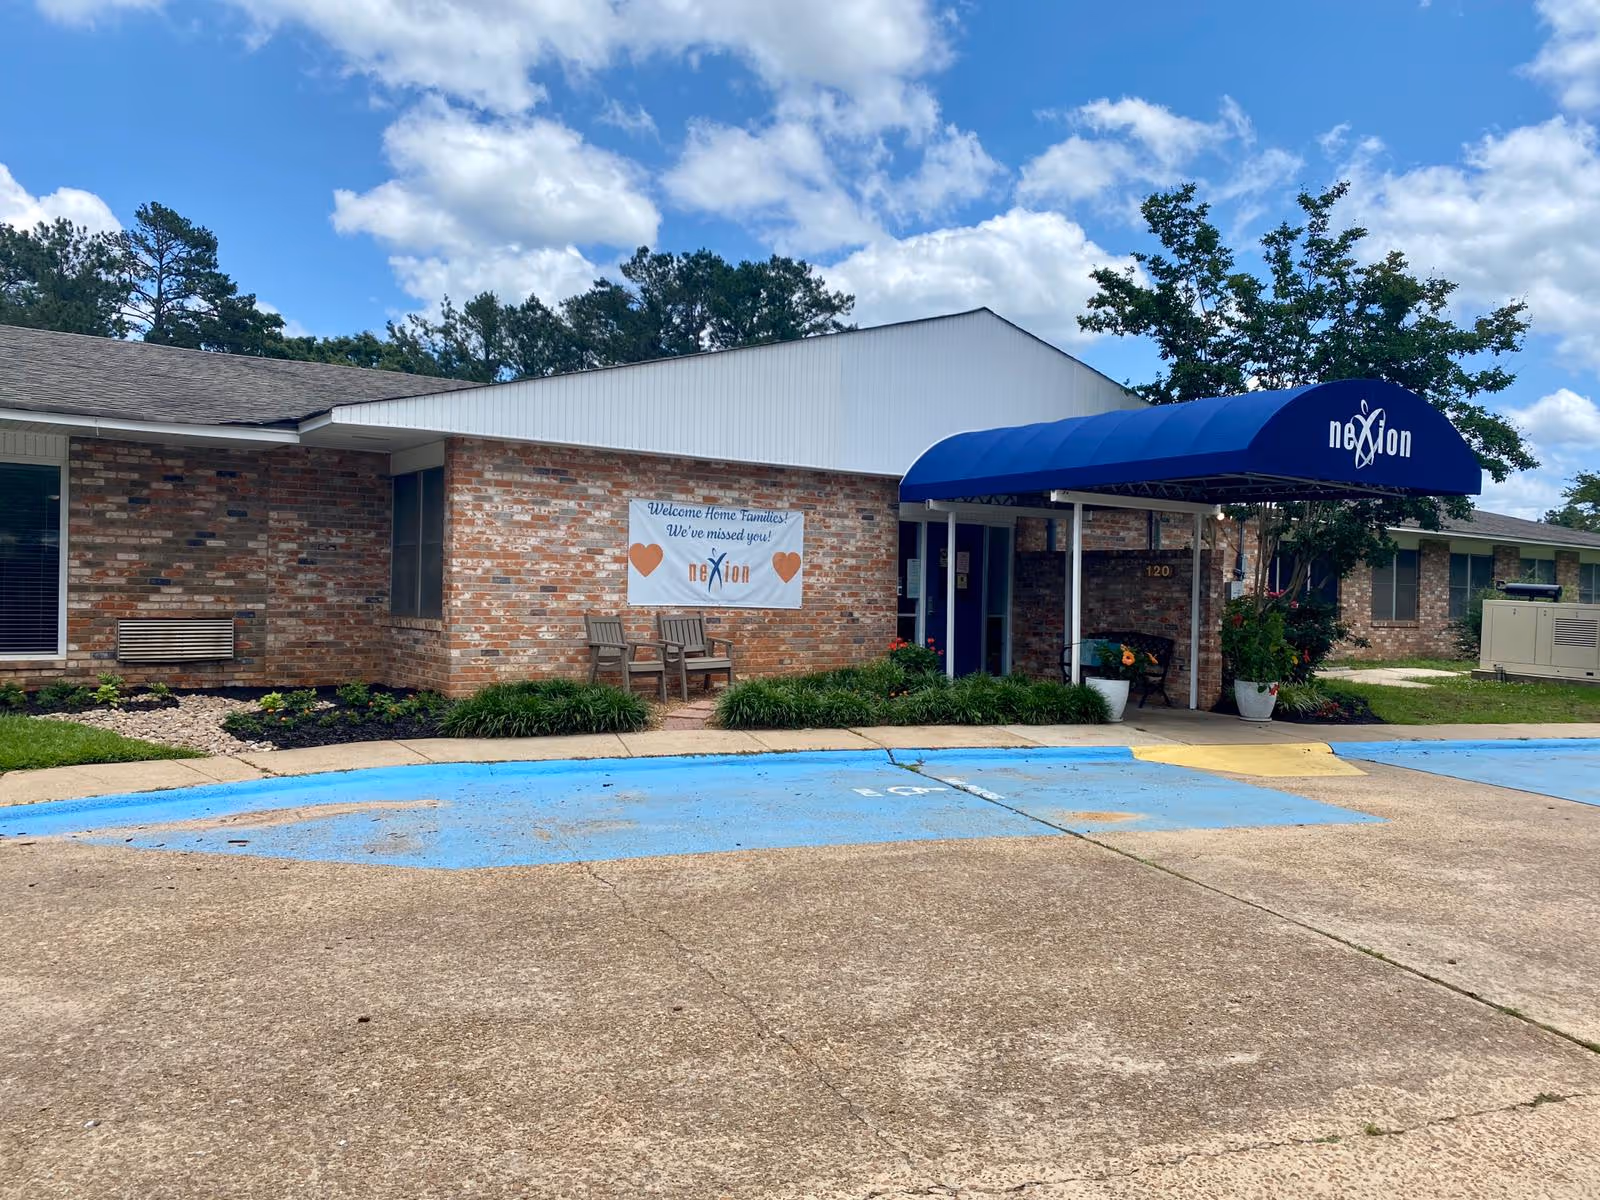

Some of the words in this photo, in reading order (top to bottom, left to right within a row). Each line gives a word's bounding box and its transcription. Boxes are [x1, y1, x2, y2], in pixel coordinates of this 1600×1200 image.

[648, 502, 702, 519] Welcome
[705, 506, 737, 520] Home
[740, 509, 788, 523] Families!
[666, 524, 704, 538] We've
[706, 528, 744, 541] missed
[747, 531, 772, 545] you!
[1146, 565, 1170, 577] 120
